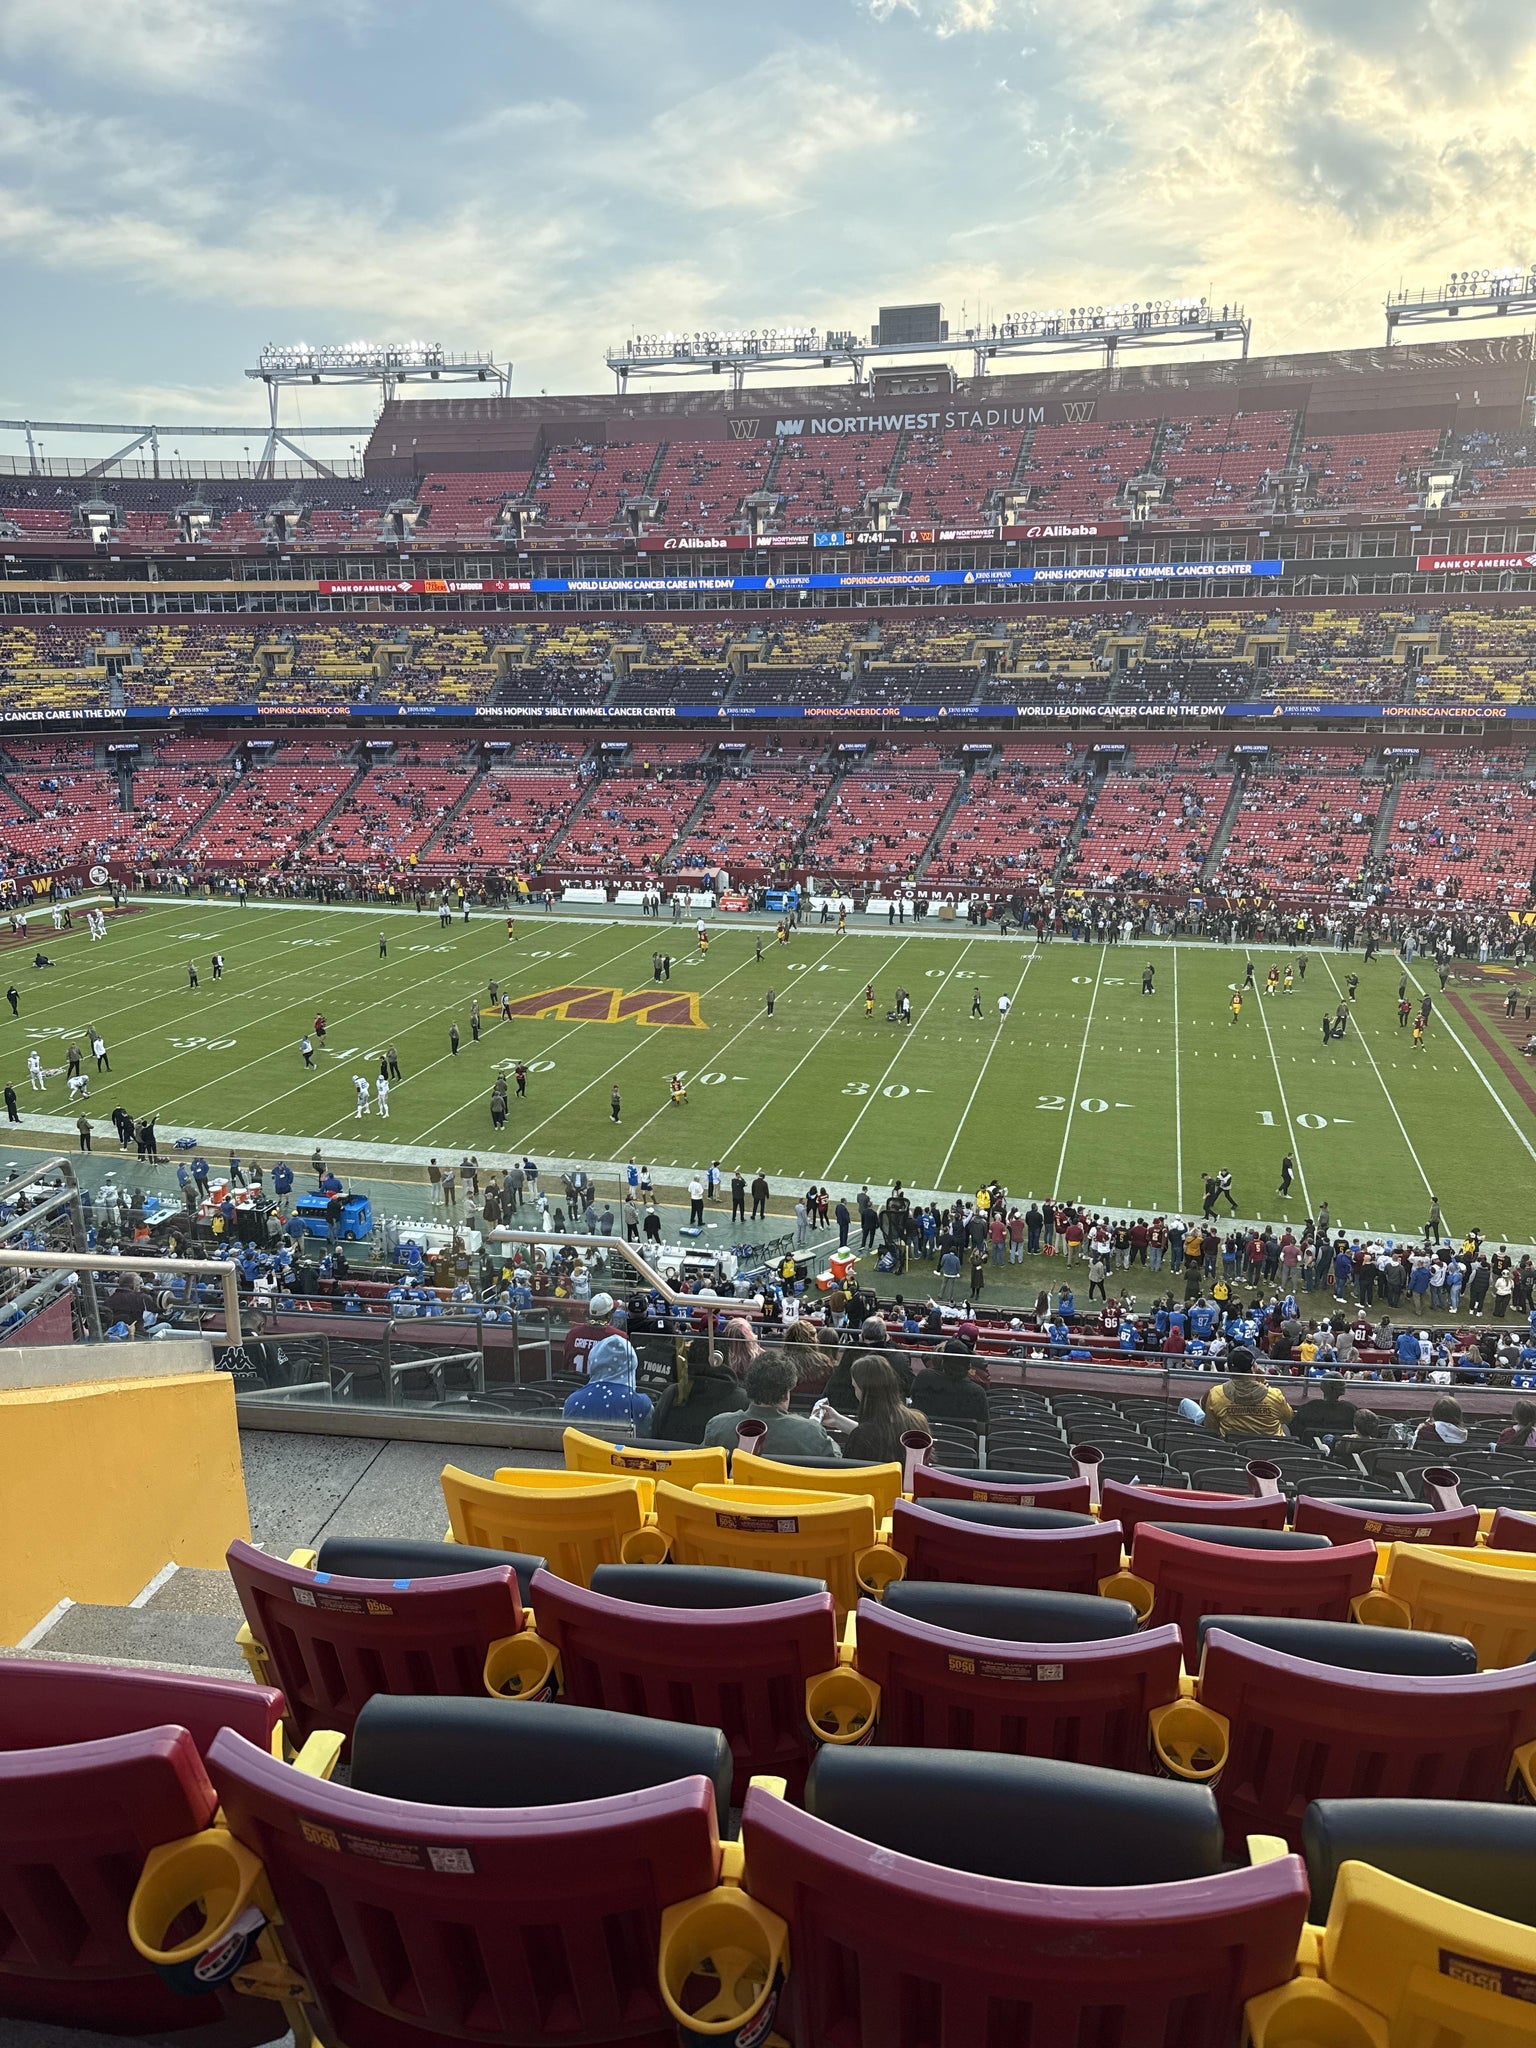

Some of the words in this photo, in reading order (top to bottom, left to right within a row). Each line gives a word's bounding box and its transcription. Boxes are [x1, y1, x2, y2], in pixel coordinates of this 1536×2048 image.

[775, 420, 804, 435] NW
[811, 413, 941, 434] NORTHWEST
[945, 407, 1044, 427] STADIUM
[1043, 525, 1098, 537] Alibaba
[679, 538, 727, 549] Alibaba
[857, 533, 883, 543] 47:41
[1433, 561, 1461, 569] BANK
[1462, 560, 1476, 568] OF
[1476, 558, 1523, 567] AMERICA
[1033, 570, 1063, 580] JOHNS
[1064, 569, 1107, 579] HOPKINS'
[1108, 568, 1137, 578] SIBLEY
[1139, 566, 1175, 577] KIMMEL
[1176, 566, 1214, 576] CANCER
[1215, 564, 1252, 575] CENTER
[567, 581, 593, 590] WORLD
[593, 581, 633, 590] LEADING
[633, 581, 666, 589] CANCER
[666, 580, 688, 589] CARE
[688, 580, 698, 589] IN
[699, 580, 713, 589] THE
[714, 580, 735, 589] DMV
[840, 575, 931, 585] HOPKINSCANCERDC.ORG
[4, 711, 45, 722] CANCER
[45, 710, 72, 721] CARE
[72, 710, 83, 720] IN
[84, 709, 104, 720] THE
[105, 708, 127, 719] DMV
[257, 707, 351, 715] HOPKINSCANCERDC.ORG
[475, 707, 503, 716] JOHNS
[504, 707, 543, 716] HOPKINS'
[545, 707, 572, 716] SIBLEY
[573, 707, 608, 716] KIMMEL
[608, 707, 643, 716] CANCER
[644, 707, 676, 716] CENTER
[804, 708, 900, 716] HOPKINSCANCERDC.ORG
[1017, 707, 1053, 716] WORLD
[1054, 707, 1097, 716] LEADING
[1097, 706, 1137, 716] CANCER
[1138, 706, 1166, 715] CARE
[1166, 706, 1178, 715] IN
[1179, 706, 1200, 715] THE
[1200, 705, 1226, 715] DMV
[1382, 707, 1507, 717] HOPKINSCANCERDC.ORG
[560, 879, 665, 888] WSHNGTON
[841, 1081, 910, 1098] 30
[1035, 1095, 1109, 1113] 20
[1255, 1110, 1328, 1129] 10
[786, 1306, 795, 1317] 21
[1354, 1330, 1366, 1341] 81
[643, 1361, 672, 1376] THOMAS
[1227, 1406, 1272, 1415] COMMANDERS
